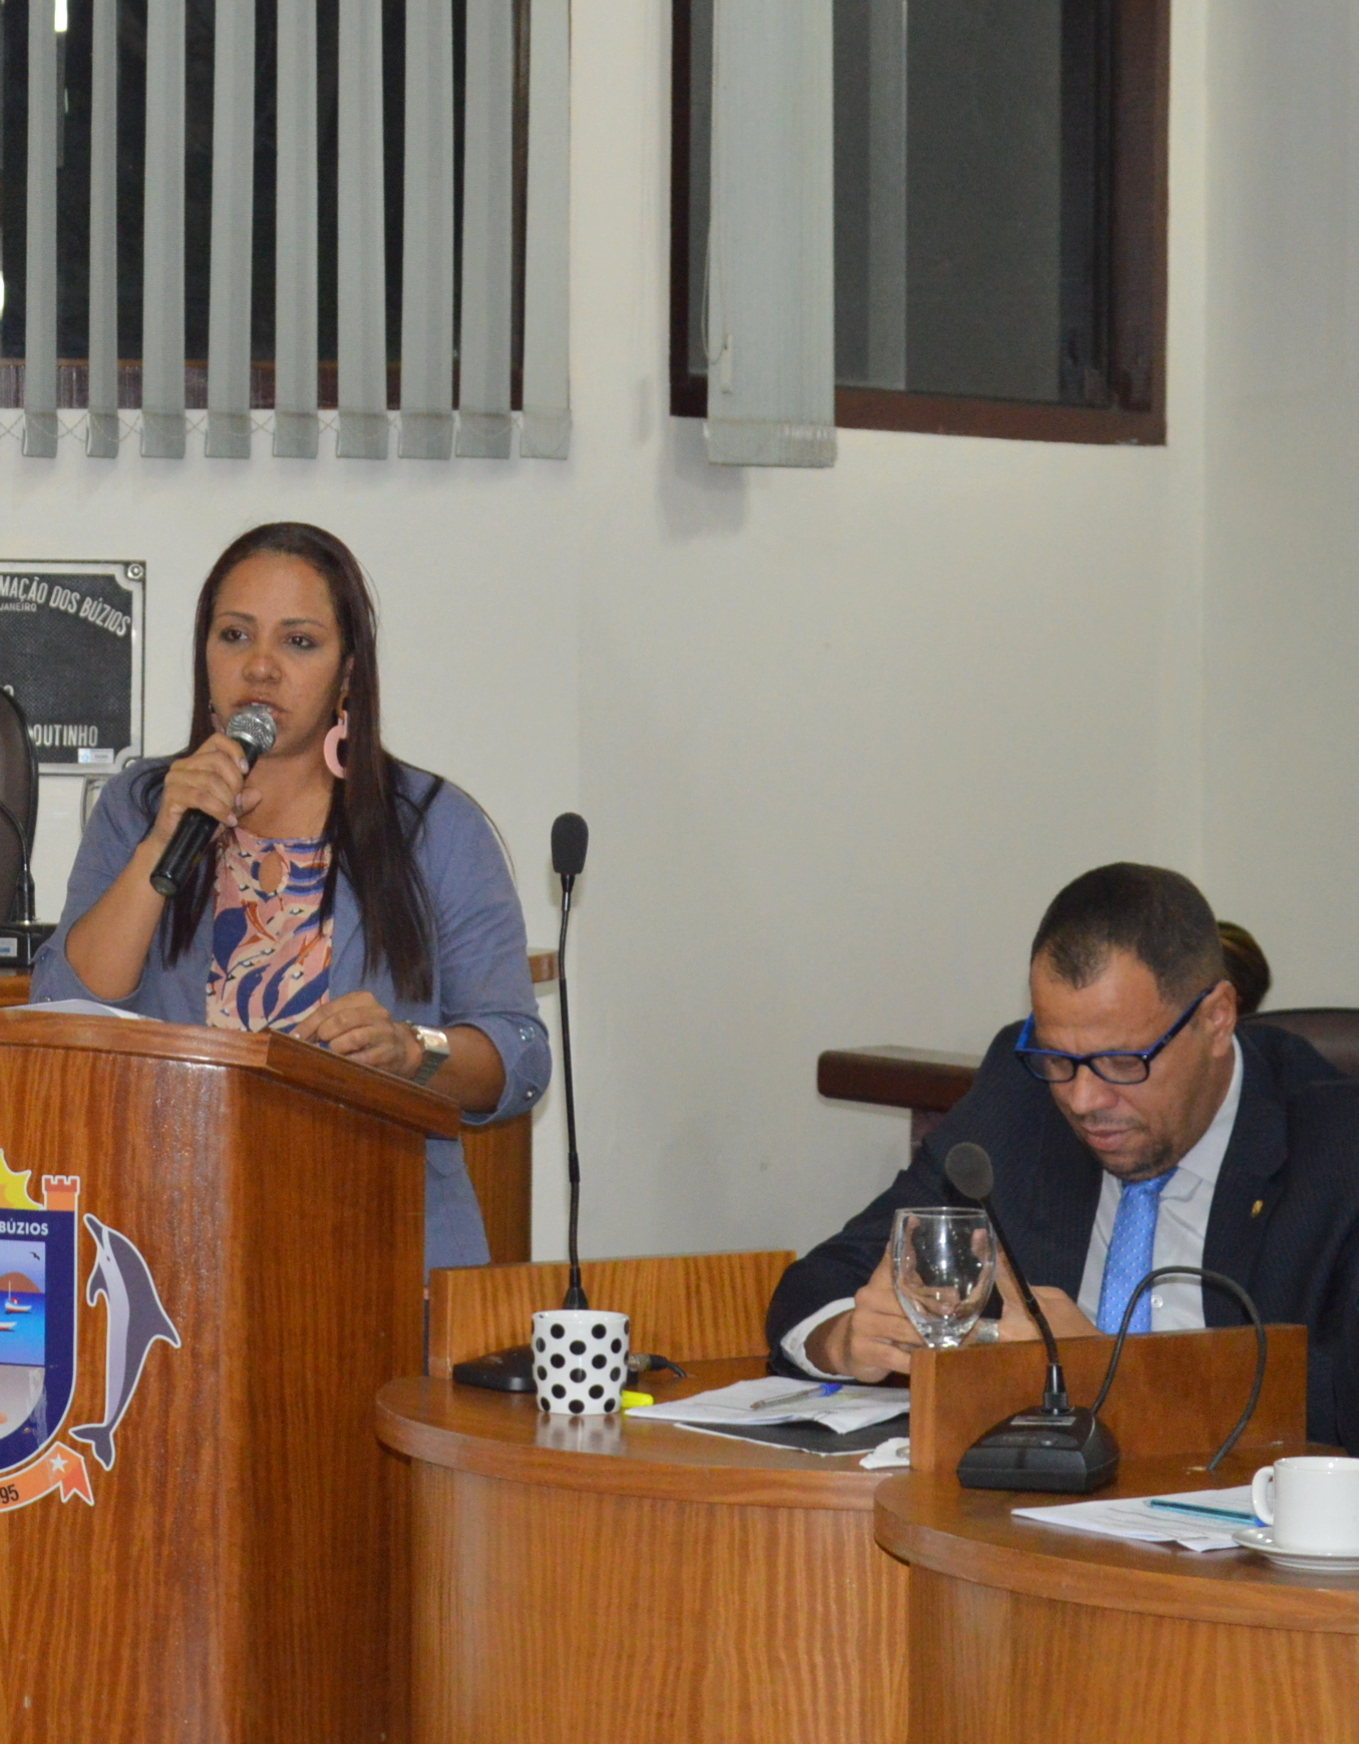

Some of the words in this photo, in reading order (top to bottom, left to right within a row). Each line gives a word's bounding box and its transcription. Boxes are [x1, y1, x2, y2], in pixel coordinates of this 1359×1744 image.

[49, 586, 81, 614] DOS
[79, 597, 131, 638] BÚZIOS
[28, 724, 98, 747] OUTINHO
